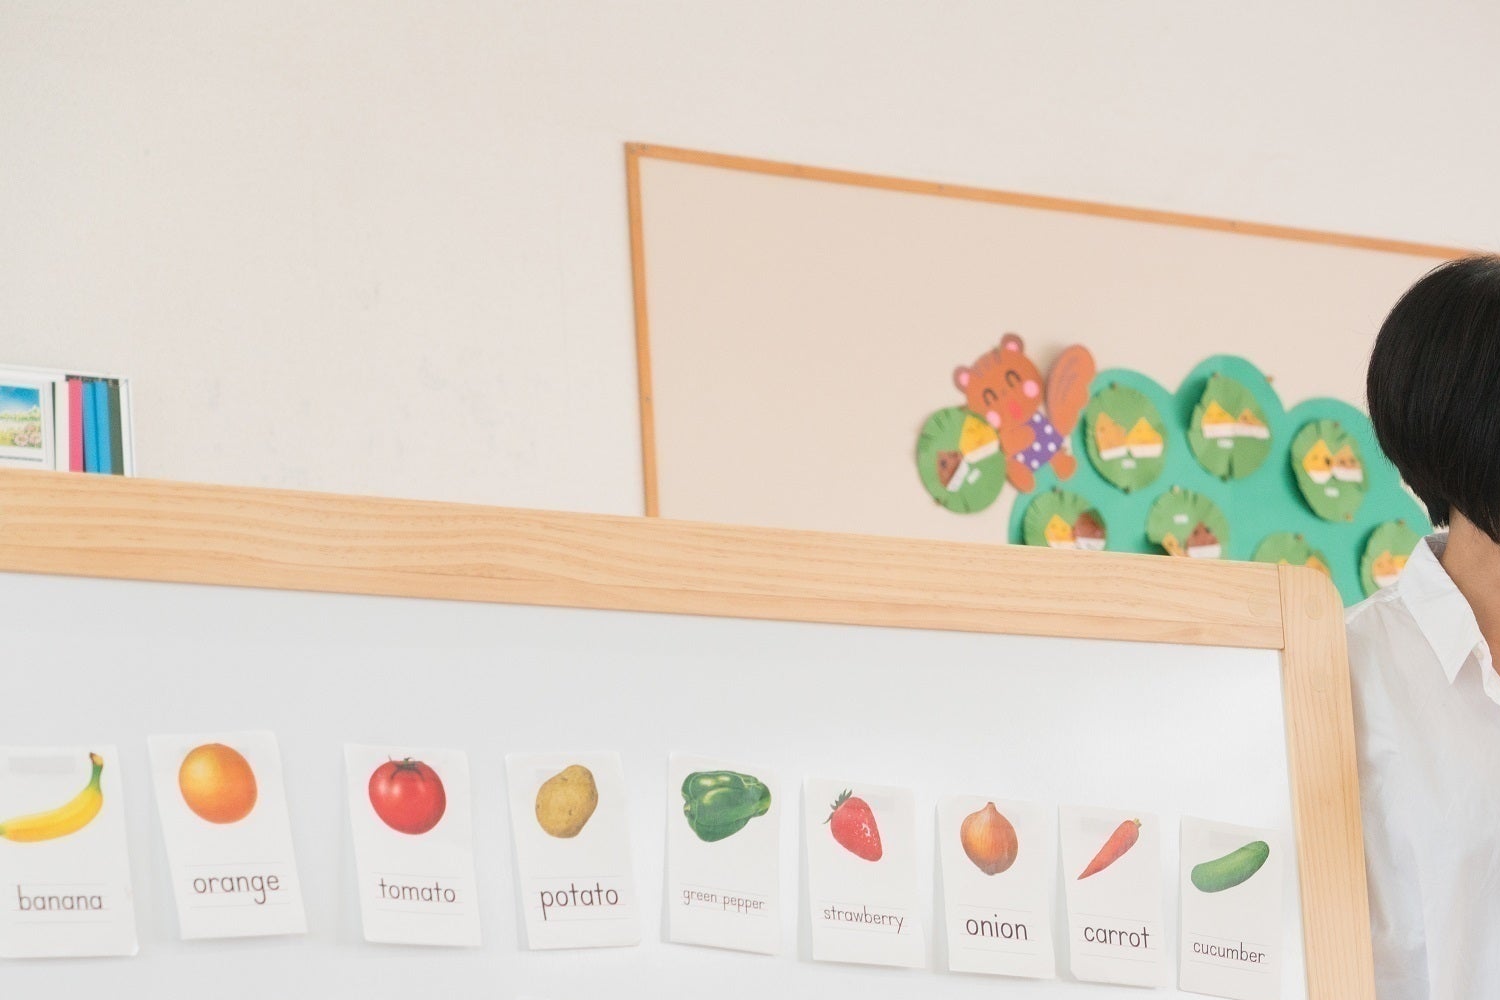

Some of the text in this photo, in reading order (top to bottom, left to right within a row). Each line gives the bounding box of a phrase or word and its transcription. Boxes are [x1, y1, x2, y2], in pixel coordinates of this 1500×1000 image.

[17, 884, 103, 911] banana
[193, 874, 280, 906] orange
[379, 878, 456, 903] tomato
[540, 882, 619, 921] potato
[682, 888, 765, 914] green pepper
[823, 904, 904, 934] strawberry
[965, 918, 1028, 941] onion
[1083, 926, 1150, 949] carrot
[1193, 941, 1266, 964] cucumber
